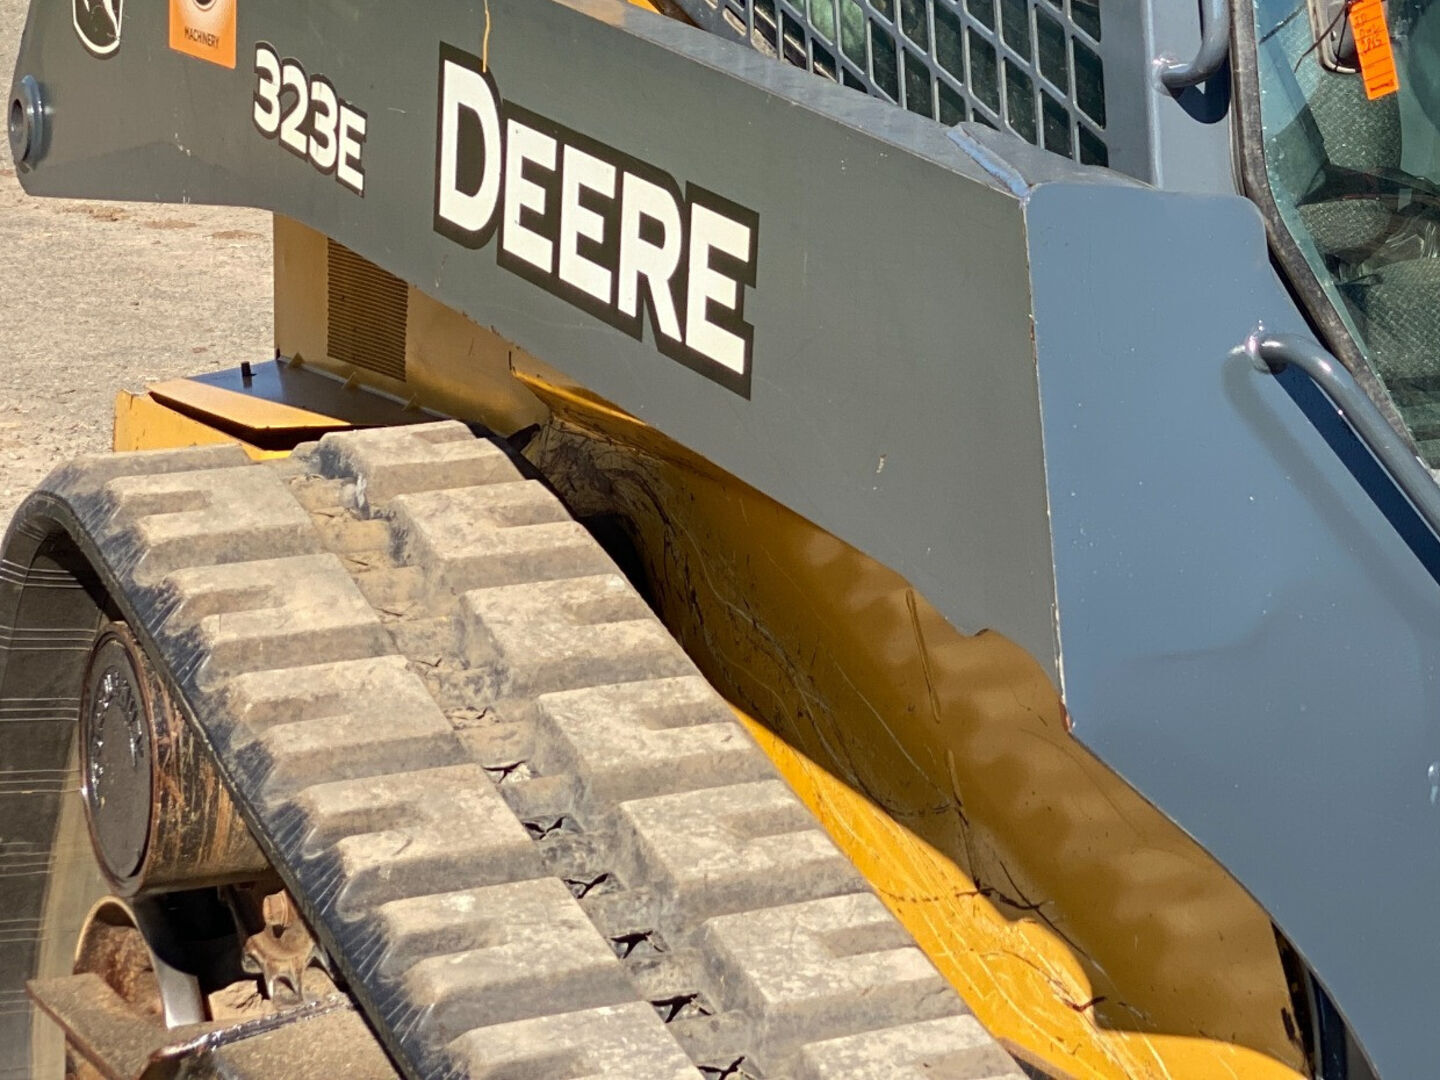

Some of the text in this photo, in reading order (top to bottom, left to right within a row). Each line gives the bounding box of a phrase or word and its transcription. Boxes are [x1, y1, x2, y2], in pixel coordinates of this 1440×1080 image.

[183, 25, 220, 50] MACHINERY
[253, 45, 368, 194] 323E
[438, 58, 752, 376] DEERE
